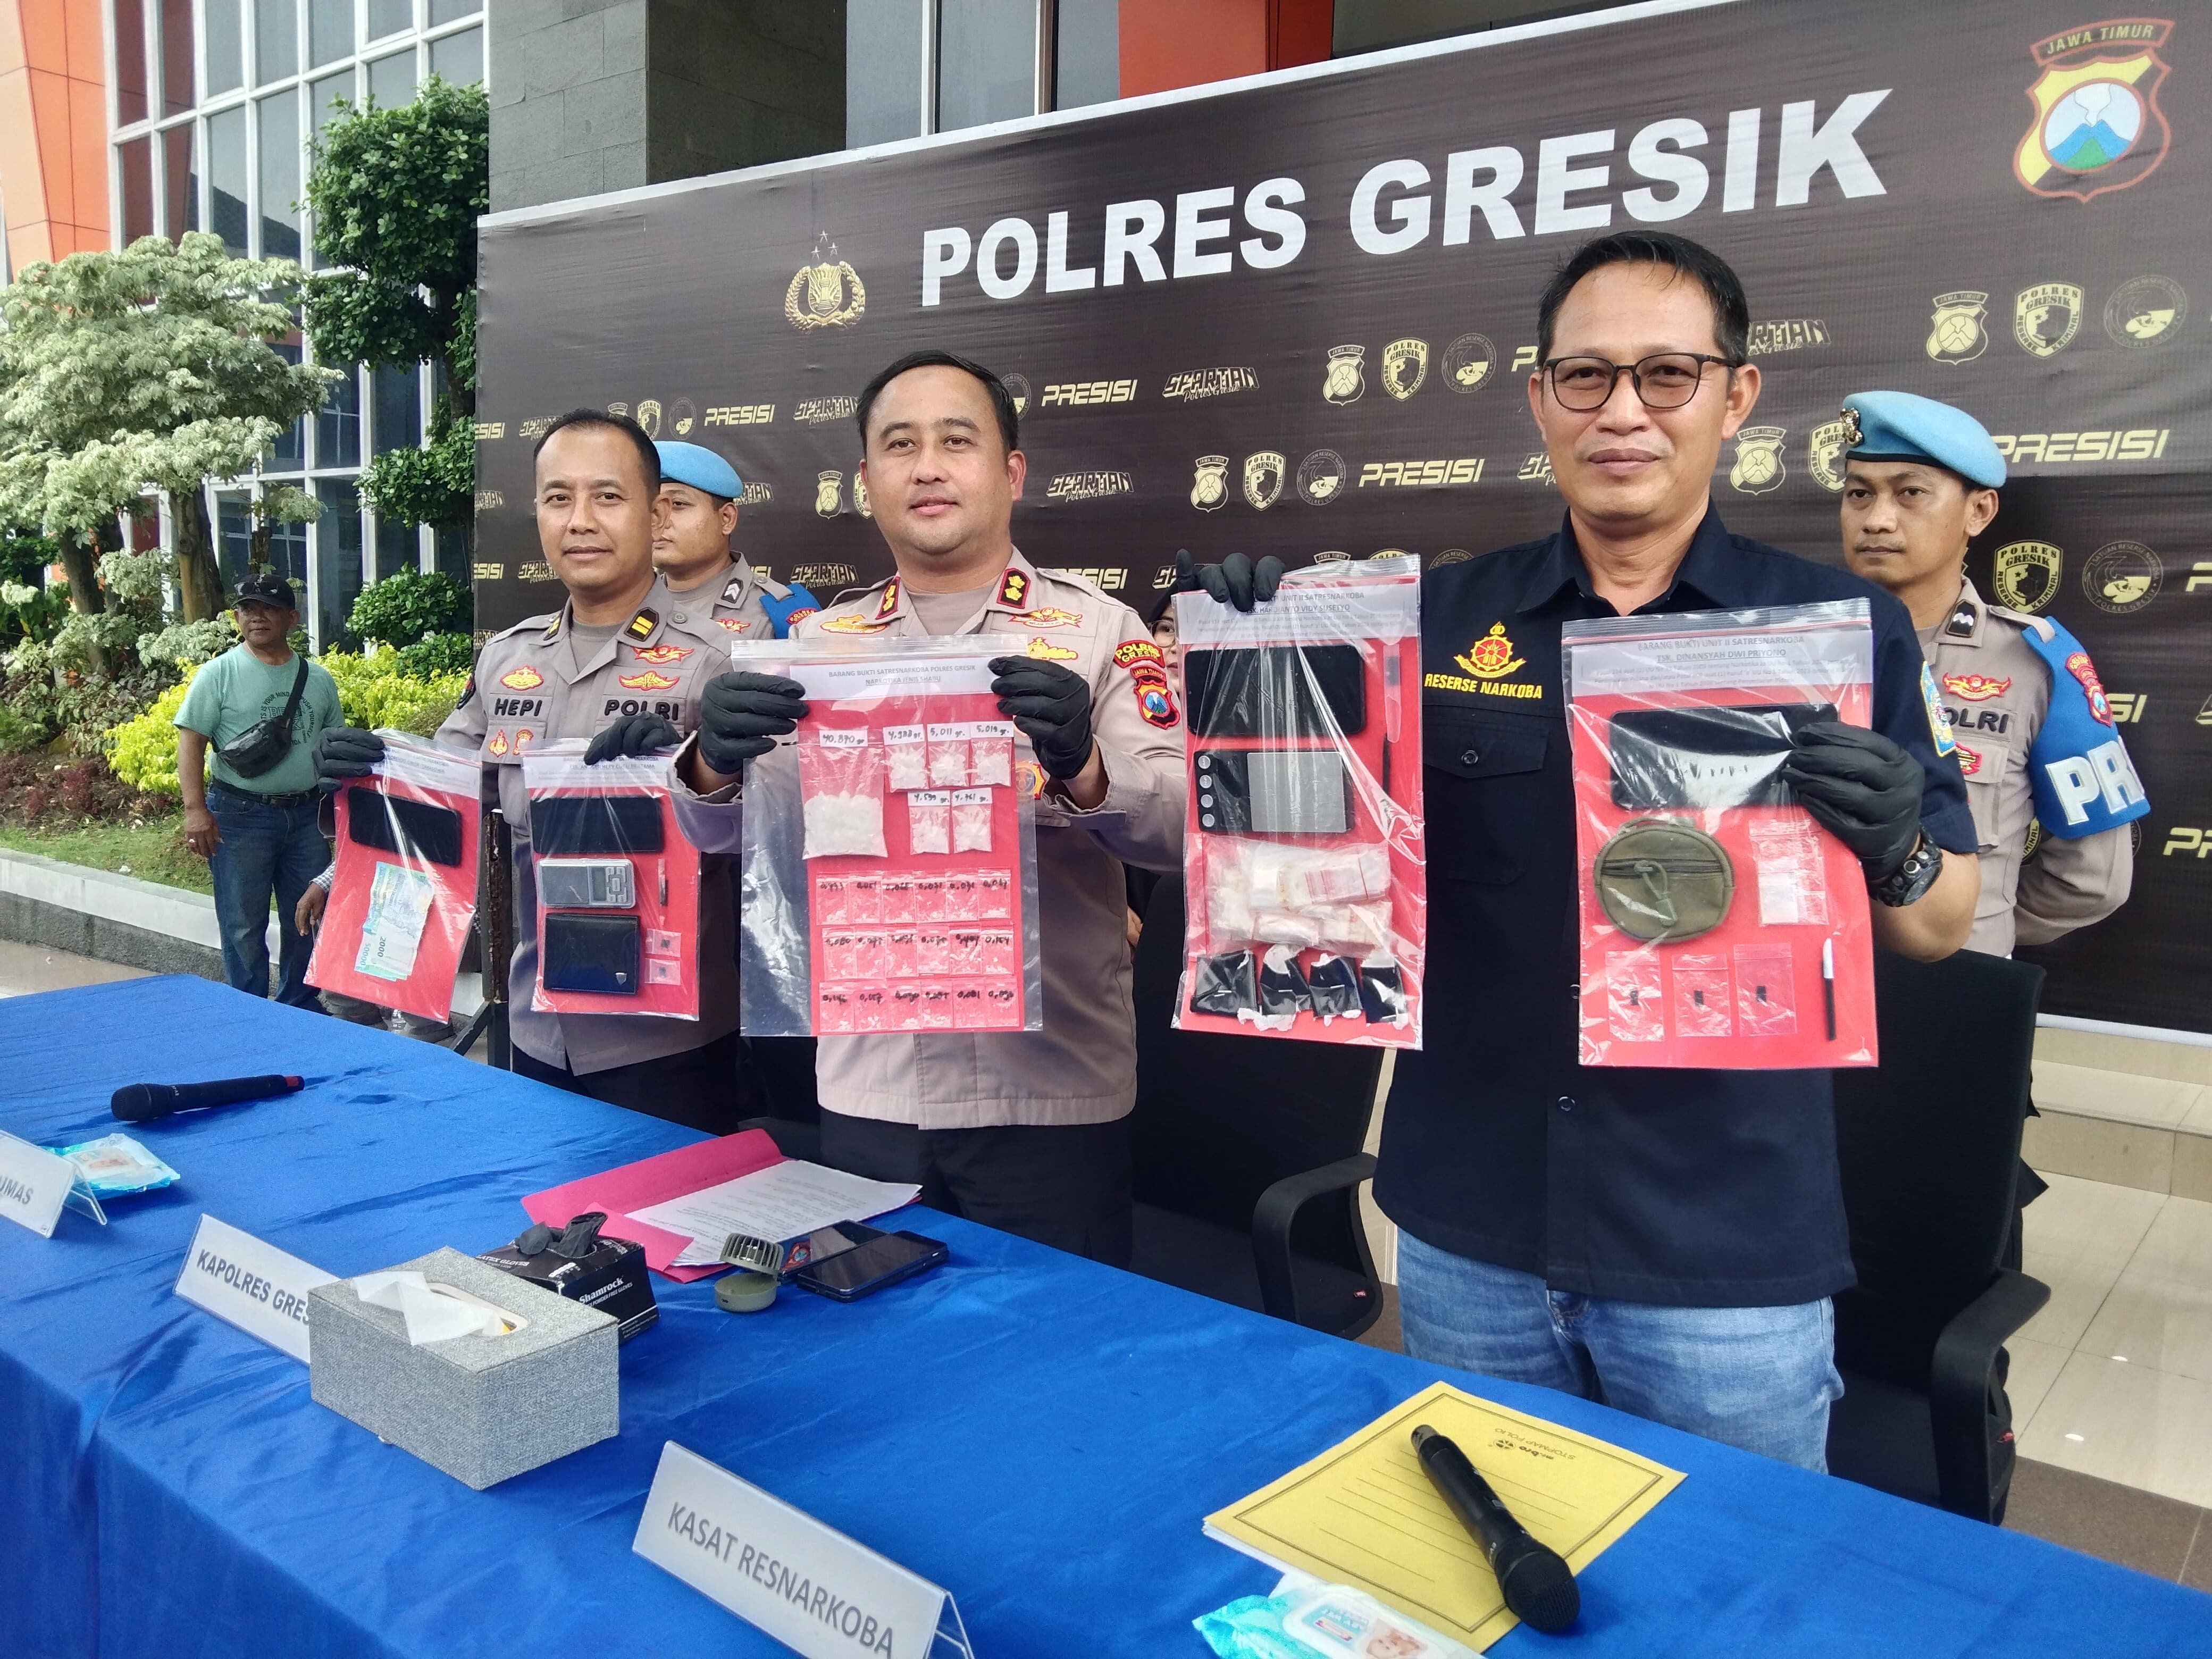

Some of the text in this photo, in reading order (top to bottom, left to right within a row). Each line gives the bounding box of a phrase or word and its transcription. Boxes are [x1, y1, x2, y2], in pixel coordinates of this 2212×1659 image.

[2047, 24, 2155, 55] JAWA TIMUR
[921, 88, 1893, 307] POLRES GRESIK
[1940, 295, 1958, 303] JAWA
[2021, 286, 2079, 302] POLRES
[2026, 295, 2071, 311] GRESIK
[2017, 315, 2038, 352] RESERSE
[2052, 311, 2079, 351] KRIMINAL
[1386, 341, 1425, 355] POLRES
[1390, 349, 1420, 361] GRESIK
[1162, 367, 1260, 398] SPARTAN
[1384, 365, 1398, 396] RESERSE
[1407, 361, 1425, 395] KRIMINAL
[1041, 380, 1138, 407] PRESISI
[1183, 389, 1213, 403] Polres
[704, 404, 775, 426] PRESISI
[1814, 424, 1845, 440] POL
[1990, 429, 2171, 464] PRESISI
[1247, 455, 1283, 467] POLRES
[1251, 462, 1278, 472] GRESIK
[1358, 458, 1485, 488] PRESISI
[1046, 471, 1134, 497] SPARTAN
[1246, 475, 1258, 505] RESERSE
[1265, 473, 1283, 505] KRIMINAL
[1434, 552, 1451, 567] SATUAN
[2000, 544, 2057, 559] POLRES
[2006, 552, 2050, 567] GRESIK
[2092, 544, 2117, 565] SATUAN
[790, 563, 859, 584] SPARTAN
[1304, 592, 1364, 601] SATRESNARKOBA
[1997, 571, 2018, 609] RESERSE
[2031, 571, 2058, 609] KRIMINAL
[2096, 588, 2156, 612] POLRES GRESIK
[1116, 643, 1161, 659] POLRES
[1638, 636, 1805, 651] BARANG BUKTI UNIT II SATRESNARKOBA
[1122, 651, 1159, 663] GRESIK
[1675, 651, 1726, 661] DINANSYAH
[1728, 650, 1746, 659] DWI
[1748, 649, 1787, 658] PRIYONO
[877, 666, 929, 675] SATRESNARKOBA
[1134, 668, 1148, 676] JAWA
[1425, 674, 1543, 699] RESERSE NARKOBA
[263, 693, 276, 706] YOUR
[300, 696, 313, 710] PUSH
[494, 698, 542, 717] HEPI
[1944, 707, 2009, 733] OLRI
[2046, 735, 2146, 825] PR
[378, 936, 387, 958] 2000
[197, 1249, 271, 1303] KAPOLRES
[579, 1277, 624, 1304] Shamrock
[617, 1281, 634, 1297] GLOVES
[1495, 1428, 1576, 1460] STOPMAP FOLIO
[667, 1501, 894, 1659] KASAT RESNARKOBA
